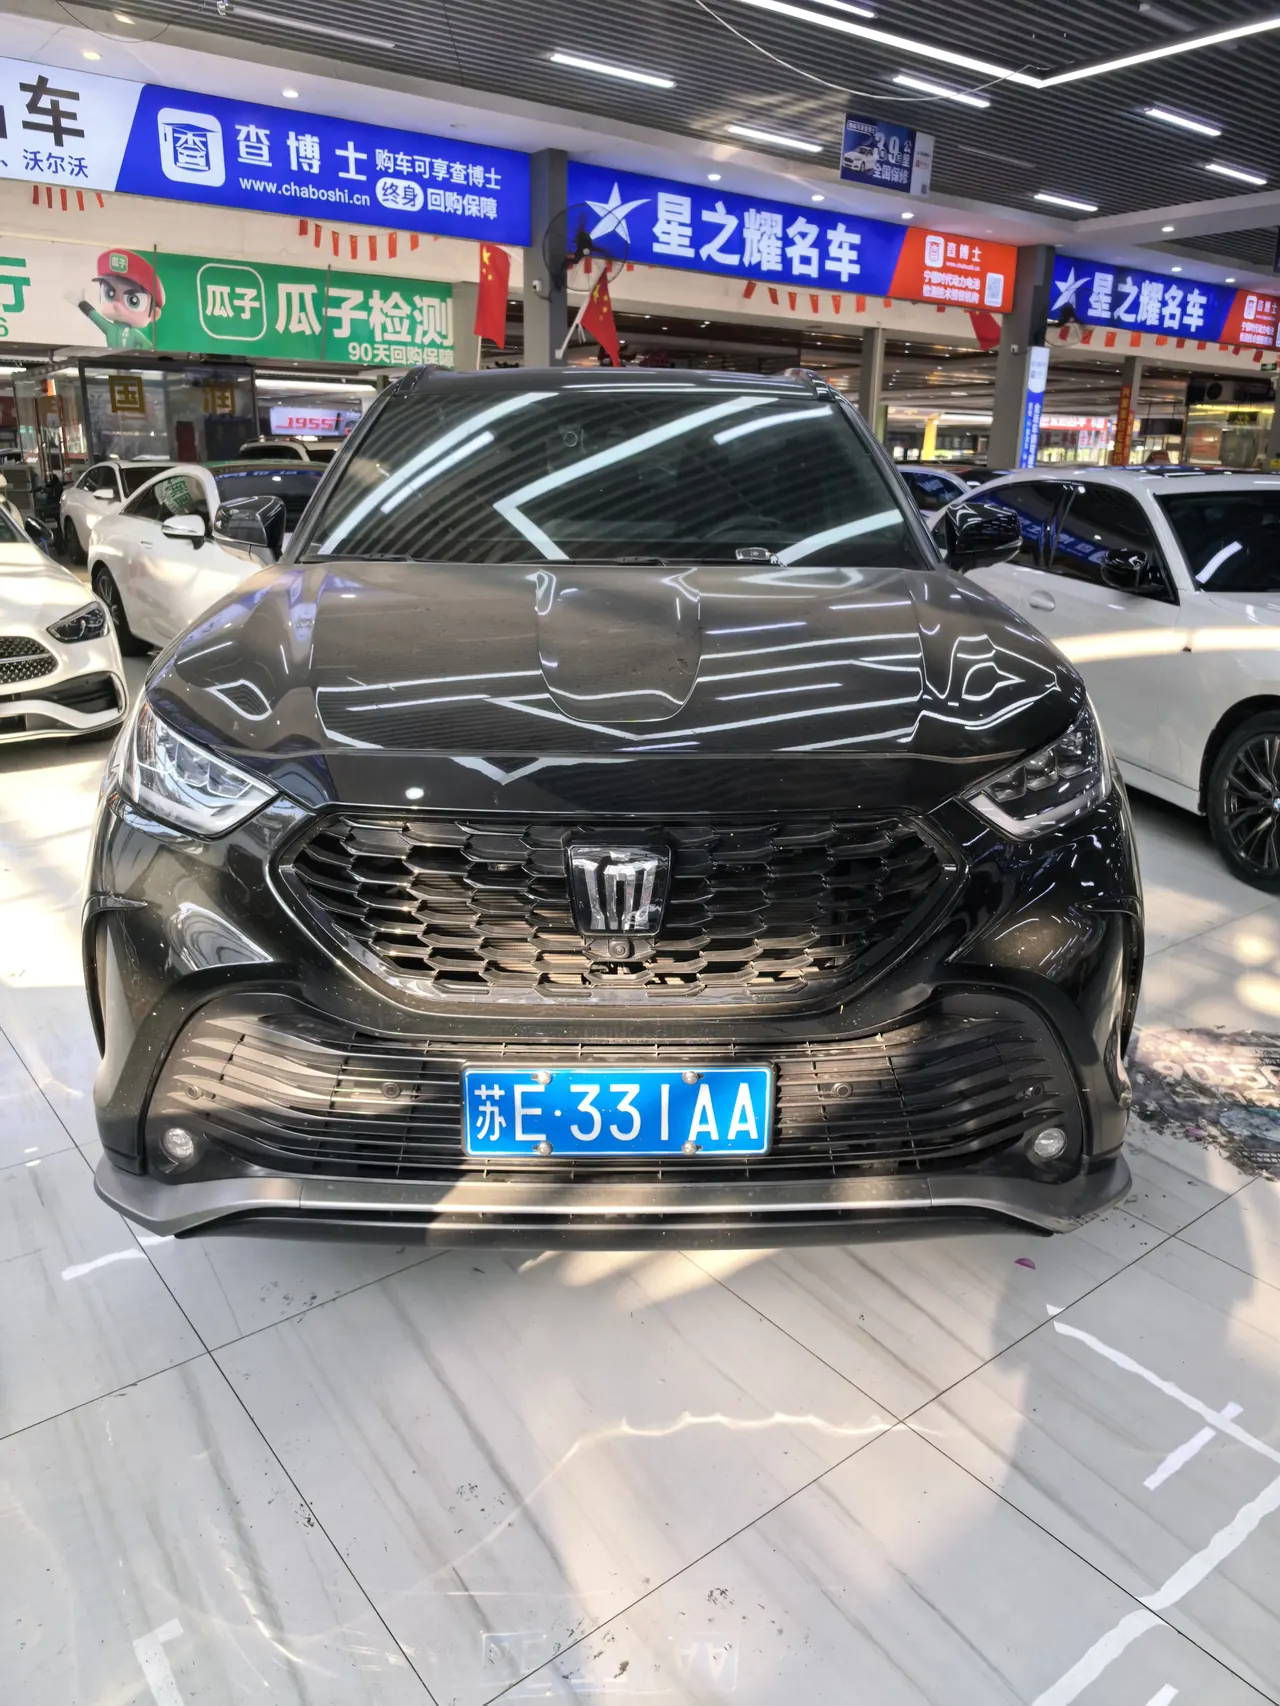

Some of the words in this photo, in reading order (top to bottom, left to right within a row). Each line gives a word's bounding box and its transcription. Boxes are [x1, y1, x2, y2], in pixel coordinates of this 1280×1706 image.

[0, 74, 85, 147] 车
[235, 124, 367, 181] 查博士
[375, 149, 501, 190] 购车可享查博士
[239, 177, 370, 206] www.chaboshi.cn
[652, 192, 861, 281] 星之耀名车
[205, 285, 260, 320] 瓜子
[275, 283, 454, 346] 瓜子检测
[1088, 272, 1207, 332] 星之耀名车
[348, 342, 454, 368] 90天回购保障
